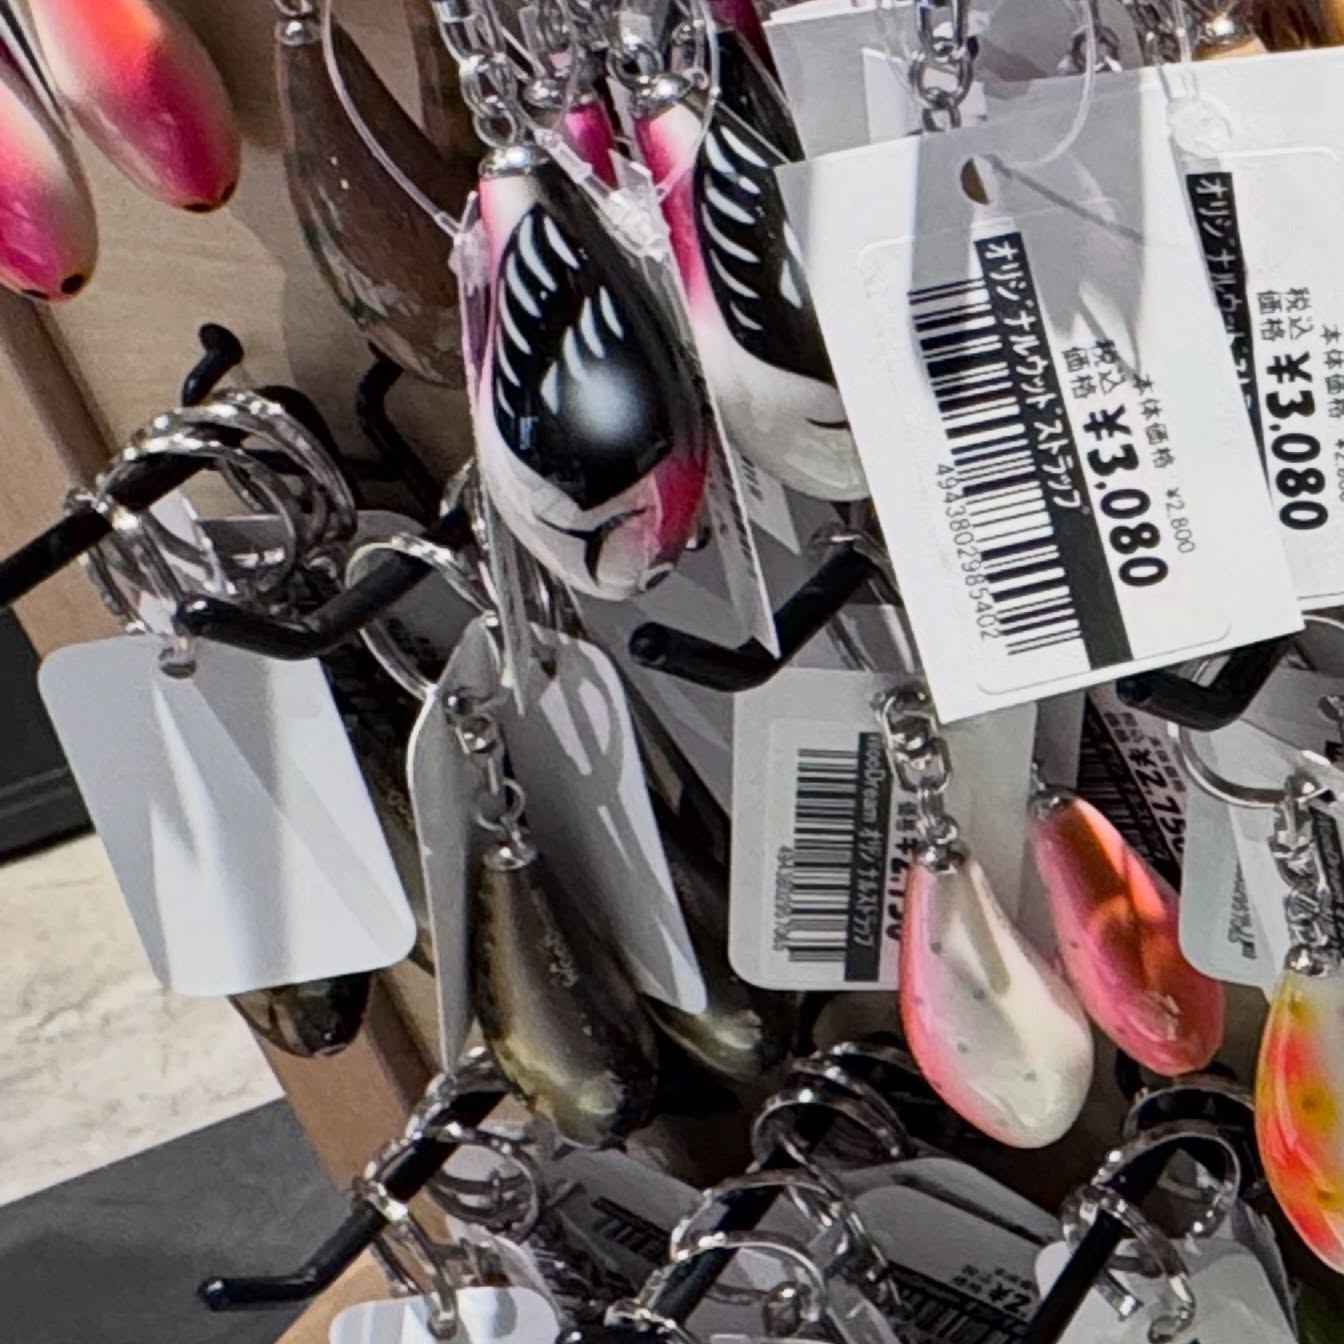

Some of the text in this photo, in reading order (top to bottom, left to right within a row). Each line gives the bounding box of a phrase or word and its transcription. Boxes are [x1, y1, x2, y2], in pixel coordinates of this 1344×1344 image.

[1256, 289, 1286, 342] 価格
[1284, 286, 1314, 340] 税込
[1062, 345, 1098, 400] 価格
[1093, 338, 1127, 397] 税込
[1132, 371, 1177, 471] 本体価格
[1264, 351, 1330, 531] ¥3,080
[1081, 403, 1169, 588] ¥3,080
